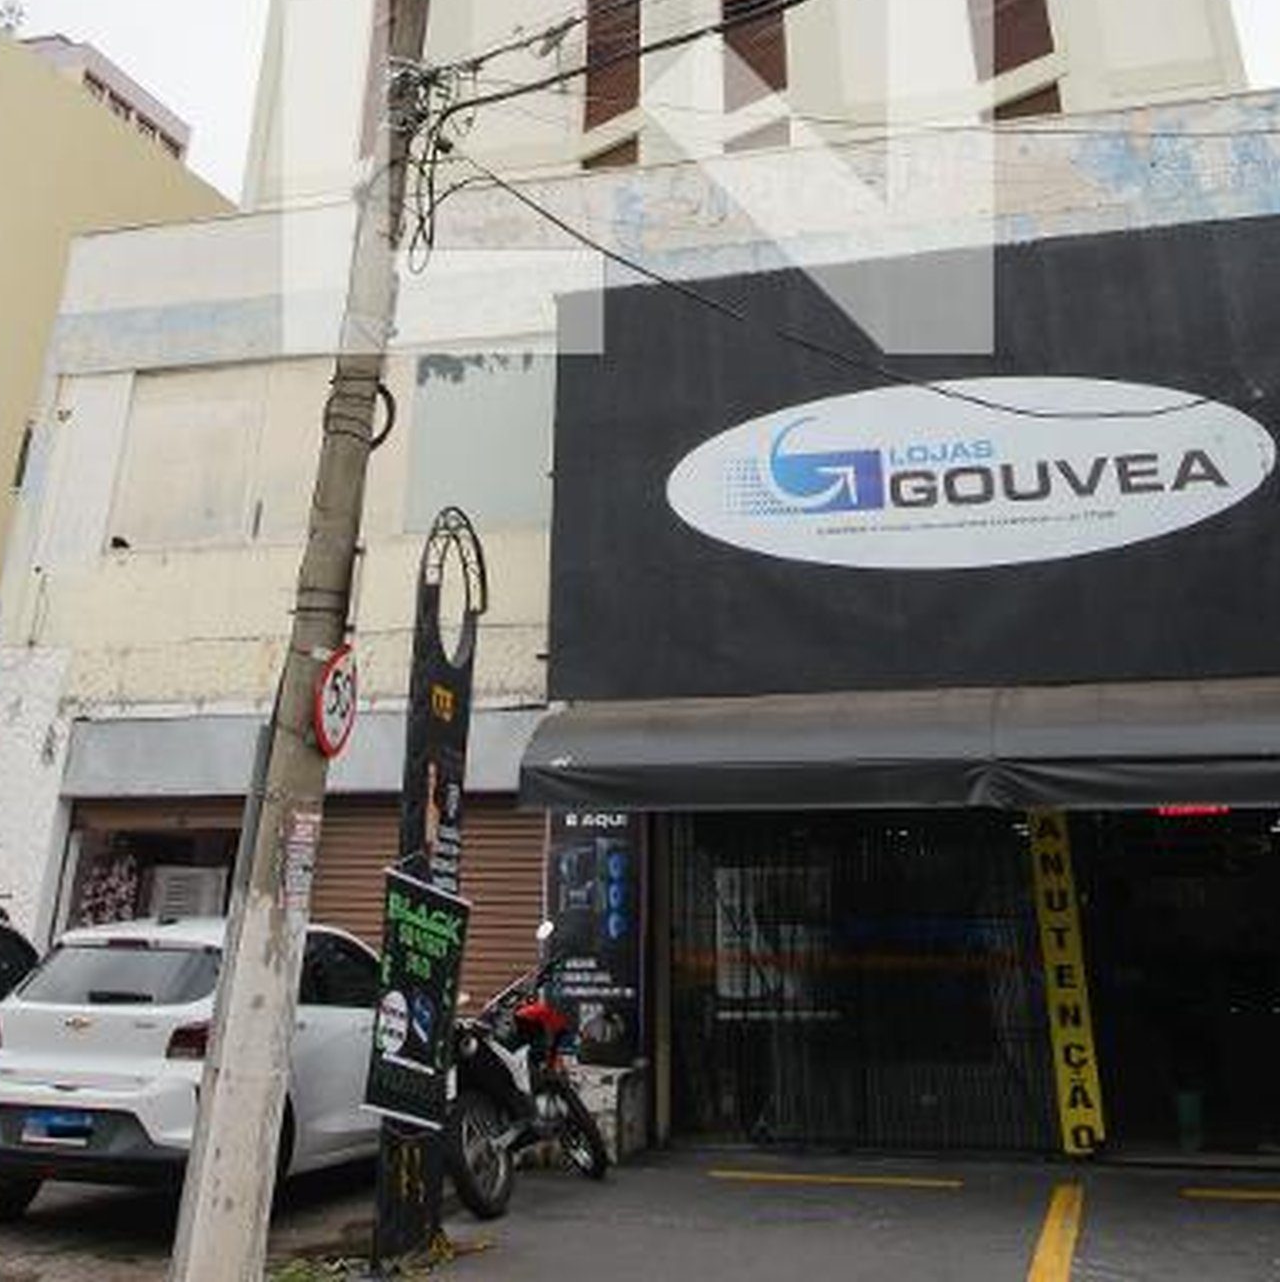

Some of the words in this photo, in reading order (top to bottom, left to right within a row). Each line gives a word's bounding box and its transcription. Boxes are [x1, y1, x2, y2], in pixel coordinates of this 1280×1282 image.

[889, 440, 993, 466] LOJAS
[889, 449, 1231, 509] GOUVEA
[327, 669, 352, 719] 50
[1035, 814, 1096, 1149] ANUTENÇÃO
